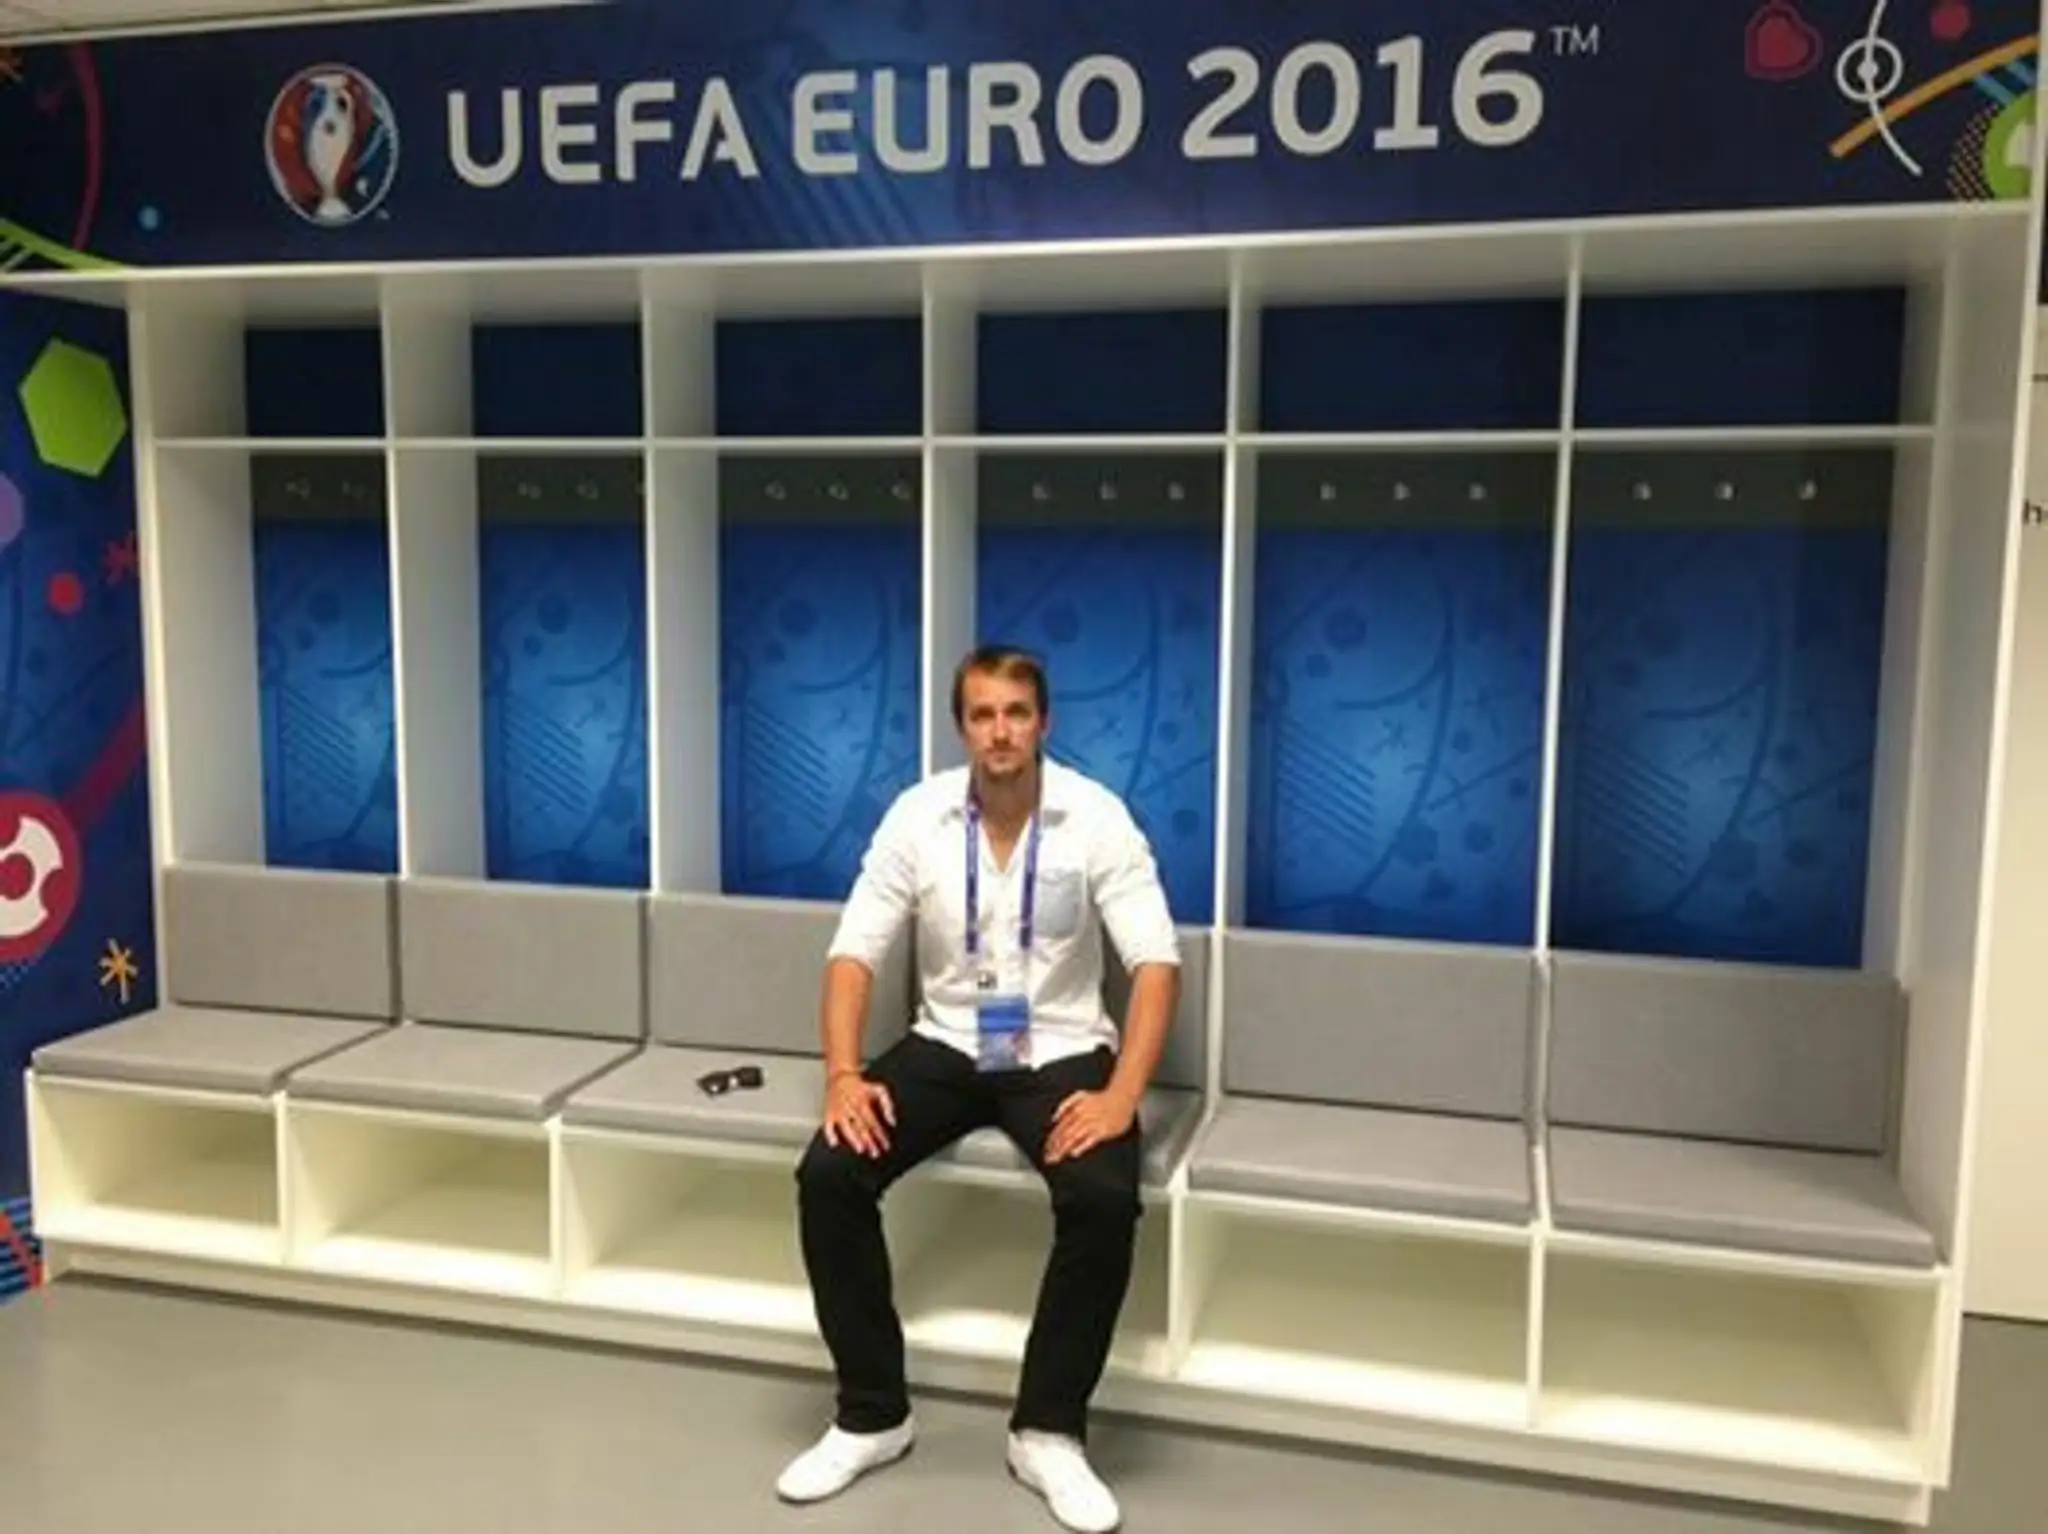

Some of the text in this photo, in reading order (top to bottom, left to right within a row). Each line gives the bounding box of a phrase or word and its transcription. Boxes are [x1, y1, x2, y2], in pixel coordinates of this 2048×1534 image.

[447, 77, 759, 187] UEFA
[792, 53, 1143, 175] EURO
[1181, 29, 1544, 157] 2016
